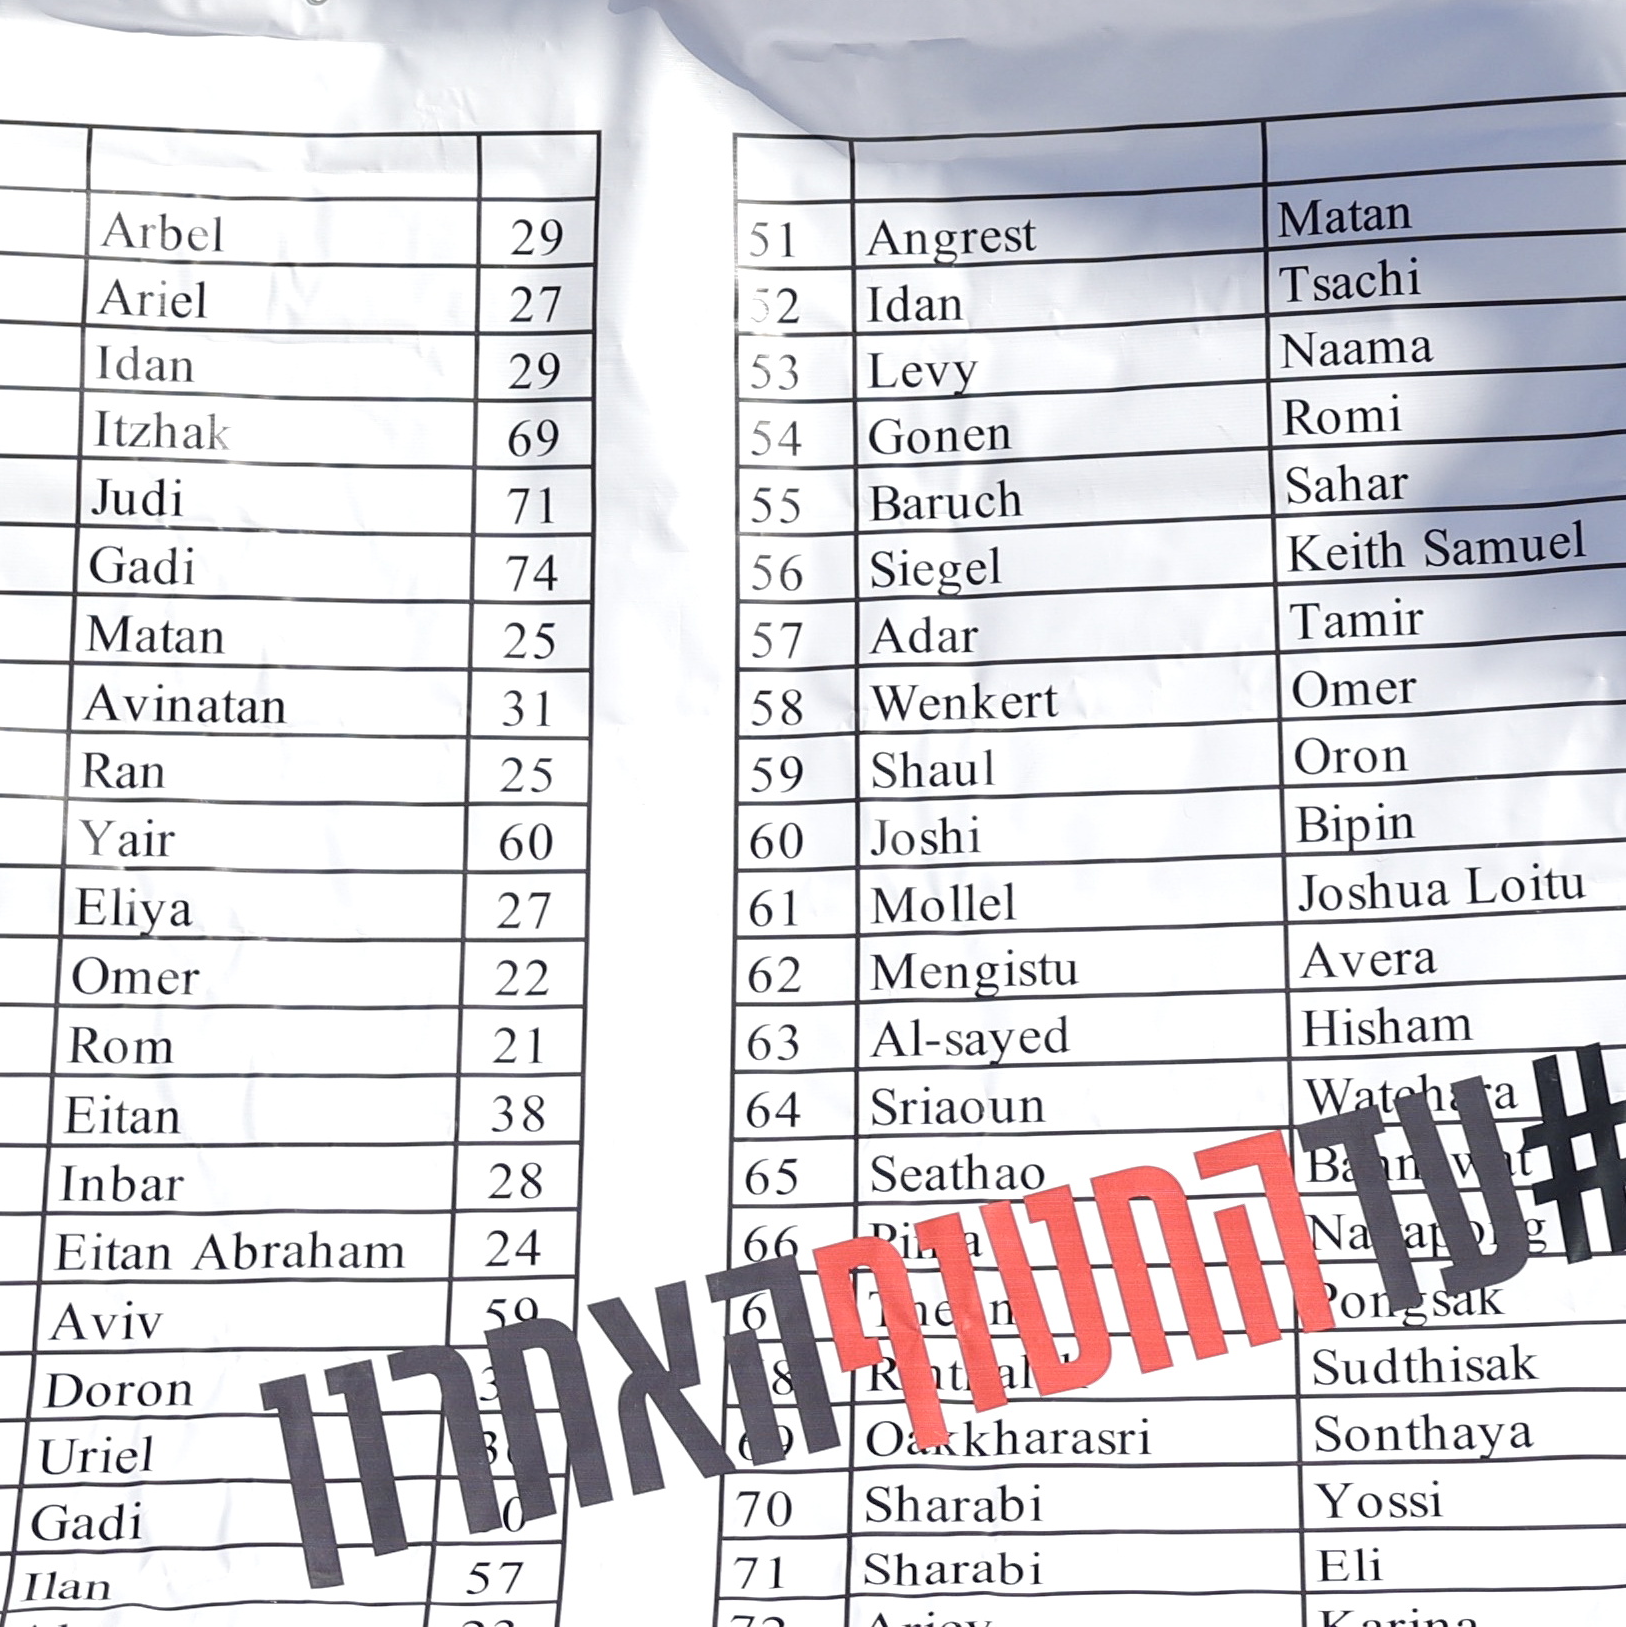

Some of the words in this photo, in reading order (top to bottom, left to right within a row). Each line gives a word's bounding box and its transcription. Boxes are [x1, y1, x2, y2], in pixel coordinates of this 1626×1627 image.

[100, 211, 224, 253] Arbel
[510, 219, 564, 256] 29
[750, 221, 796, 258] 51
[866, 219, 1037, 266] Angrest
[1278, 198, 1412, 238] Matan
[751, 554, 803, 592] 56
[871, 547, 1002, 596] Siegel
[1287, 531, 1405, 573] Keith
[1424, 520, 1587, 568] Samuel
[72, 957, 200, 995] Omer
[495, 960, 549, 996] 22
[54, 1233, 171, 1271] Eitan
[194, 1231, 405, 1270] Abraham
[485, 1231, 541, 1267] 24
[812, 1130, 1335, 1450] החטוף
[43, 1374, 193, 1408] Doron
[259, 1255, 840, 1589] האחרון
[737, 1491, 793, 1527] 70
[865, 1485, 1043, 1523] Sharabi
[1315, 1480, 1444, 1521] Yossi
